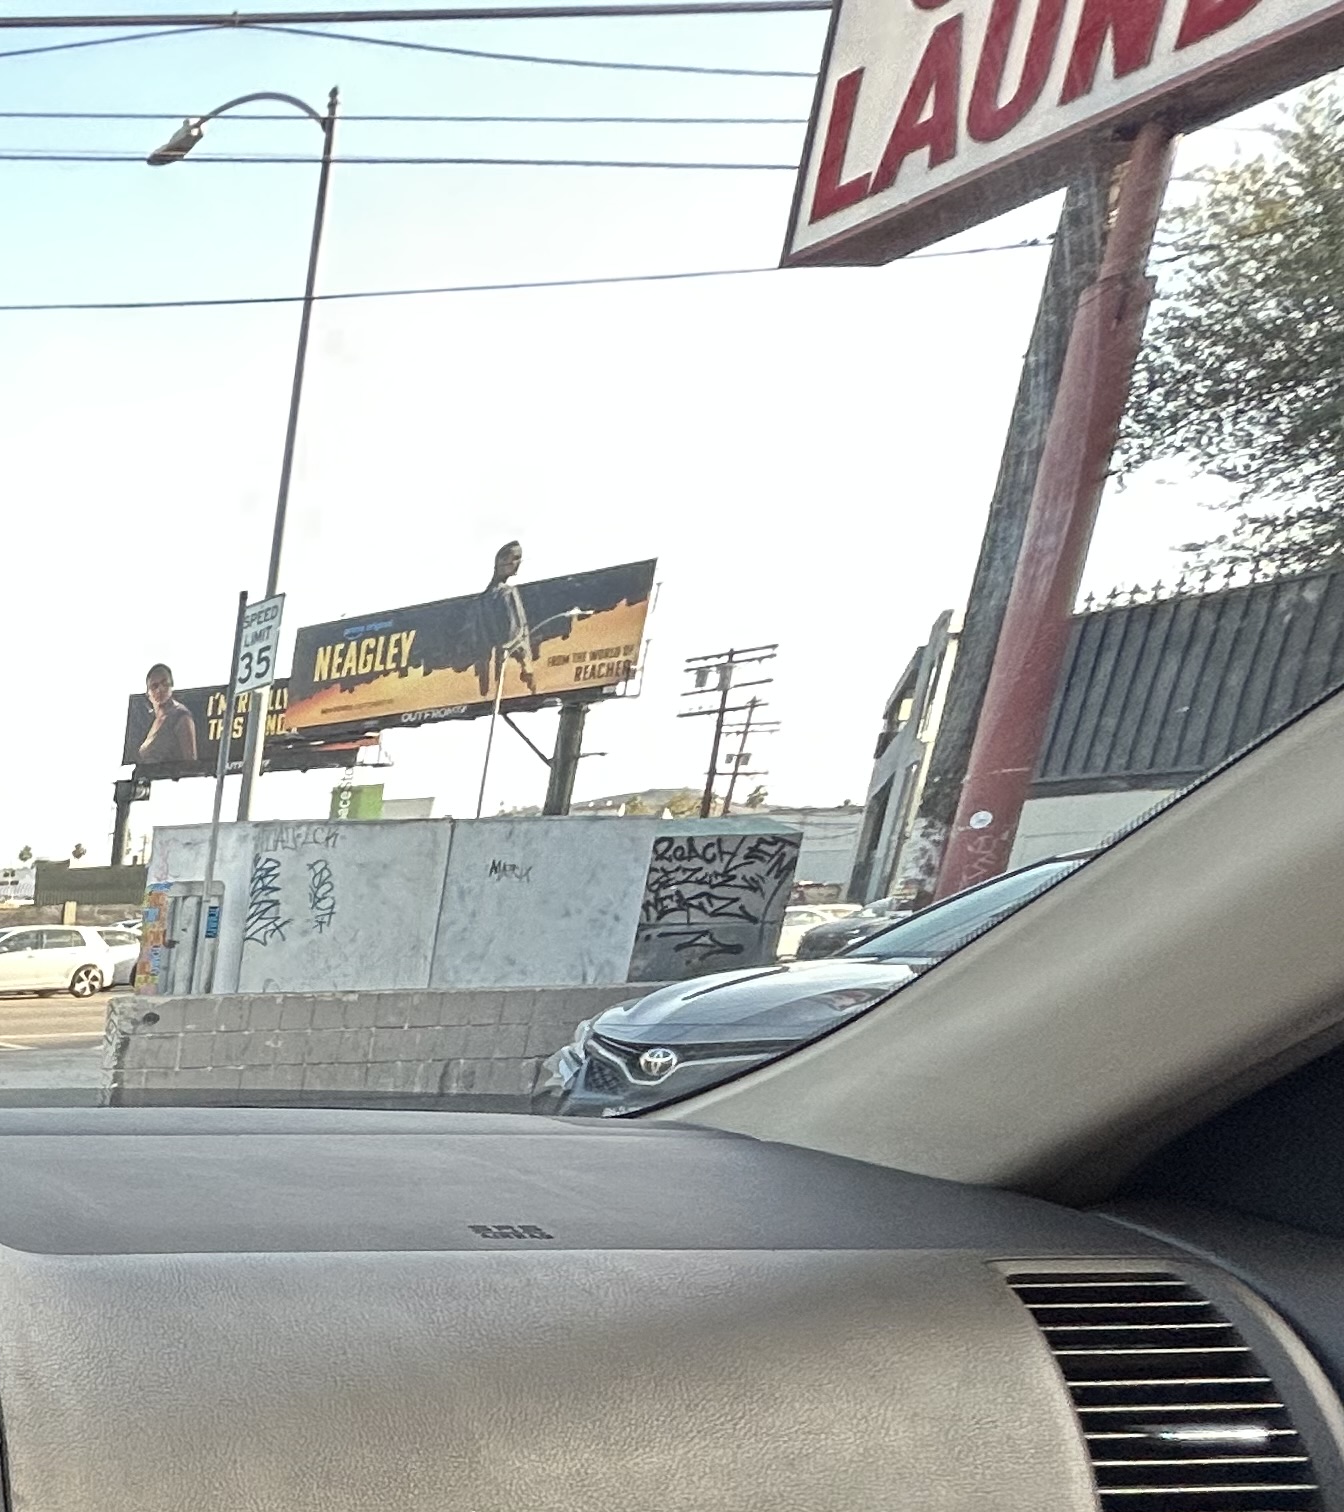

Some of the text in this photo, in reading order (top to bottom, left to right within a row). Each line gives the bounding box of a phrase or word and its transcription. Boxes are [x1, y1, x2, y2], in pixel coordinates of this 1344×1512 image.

[243, 604, 279, 629] SPEED
[244, 624, 272, 647] LIMIT
[238, 645, 271, 684] 35
[314, 629, 416, 682] NEAGLEY
[574, 659, 633, 682] REACHER
